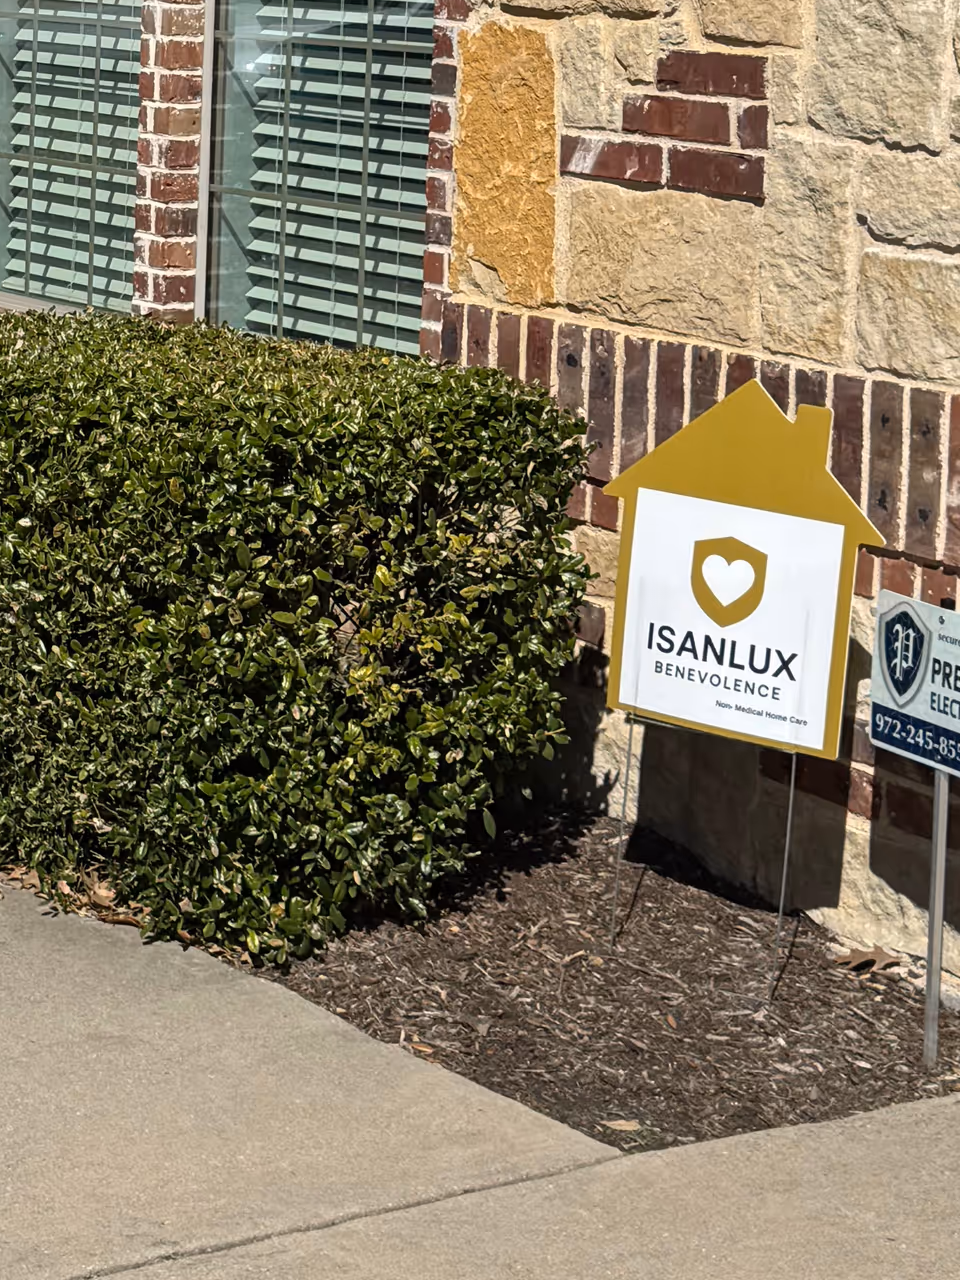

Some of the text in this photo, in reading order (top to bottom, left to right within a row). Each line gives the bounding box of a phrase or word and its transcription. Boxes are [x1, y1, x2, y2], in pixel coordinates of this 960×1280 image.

[647, 622, 798, 682] ISANLUX
[654, 660, 781, 701] BENEVOLENCE
[734, 704, 763, 717] Medical
[765, 711, 788, 722] Home
[789, 716, 808, 726] Care
